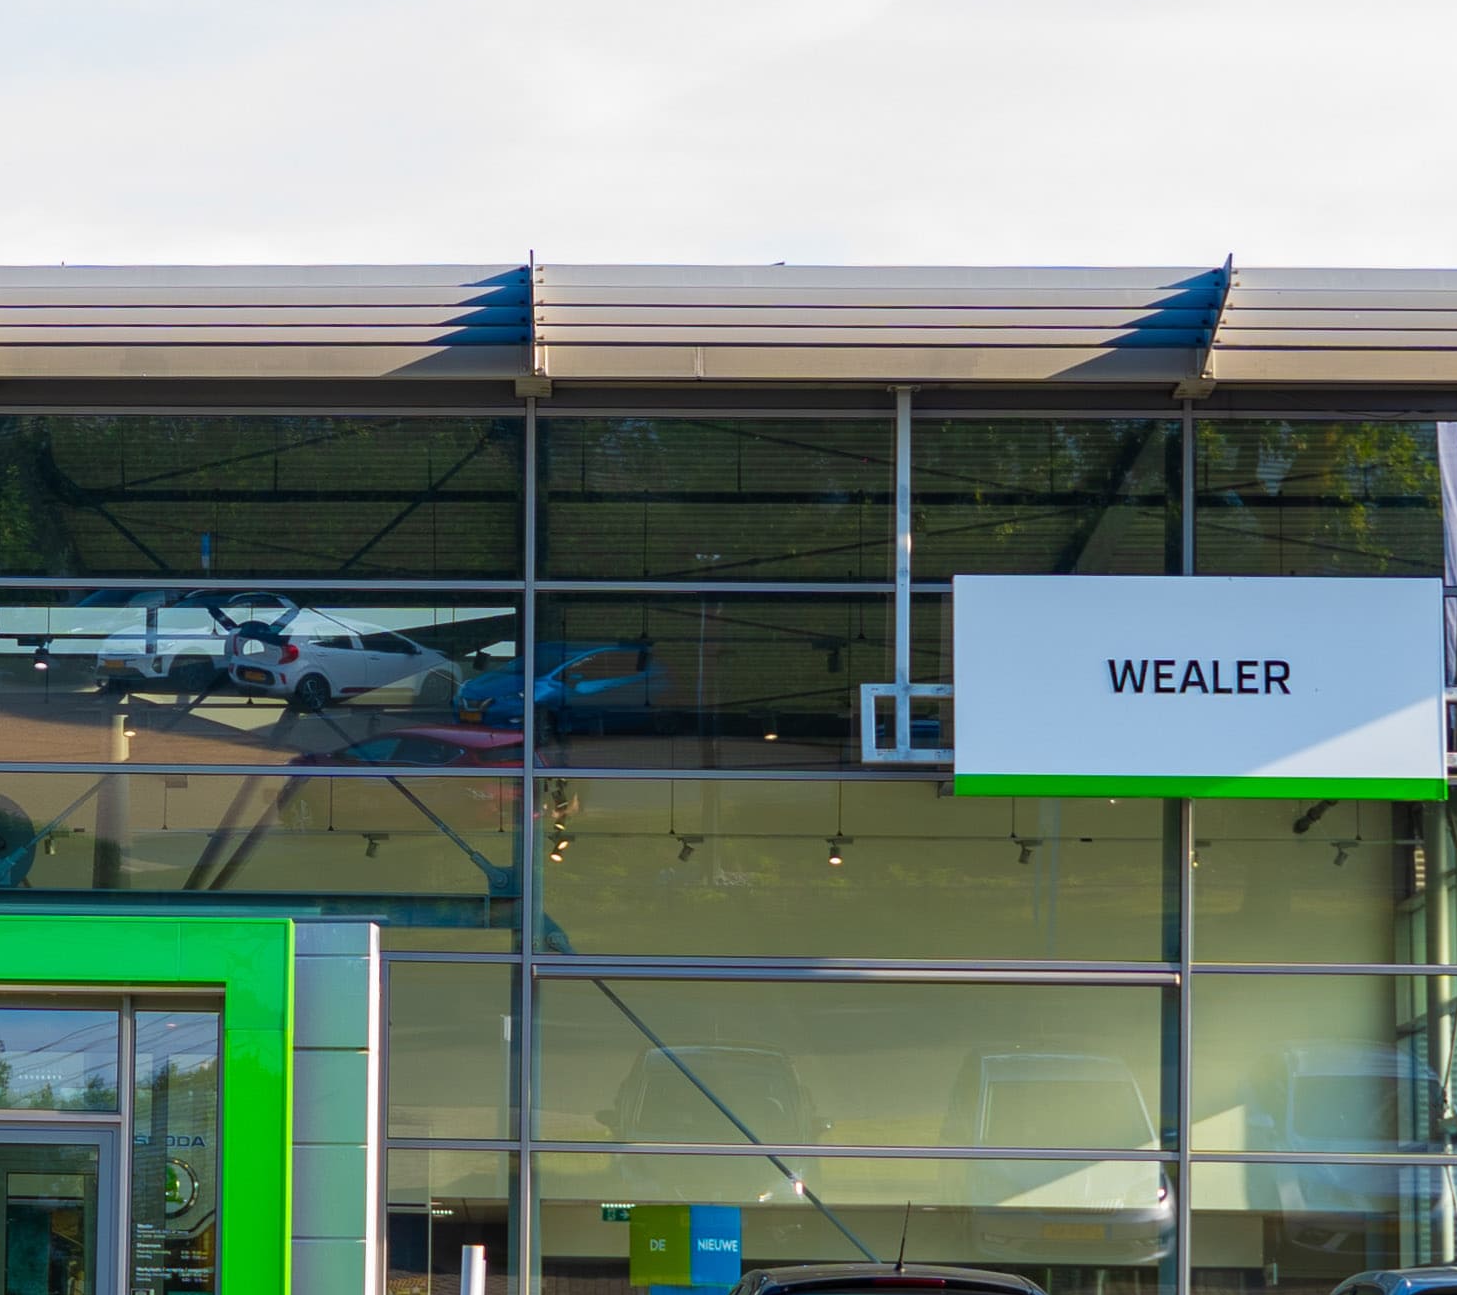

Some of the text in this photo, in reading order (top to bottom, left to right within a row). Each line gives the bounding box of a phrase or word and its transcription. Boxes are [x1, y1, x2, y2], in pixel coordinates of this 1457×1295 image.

[1107, 658, 1292, 695] WEALER
[650, 1239, 666, 1251] DE
[698, 1239, 738, 1252] NIEUWE
